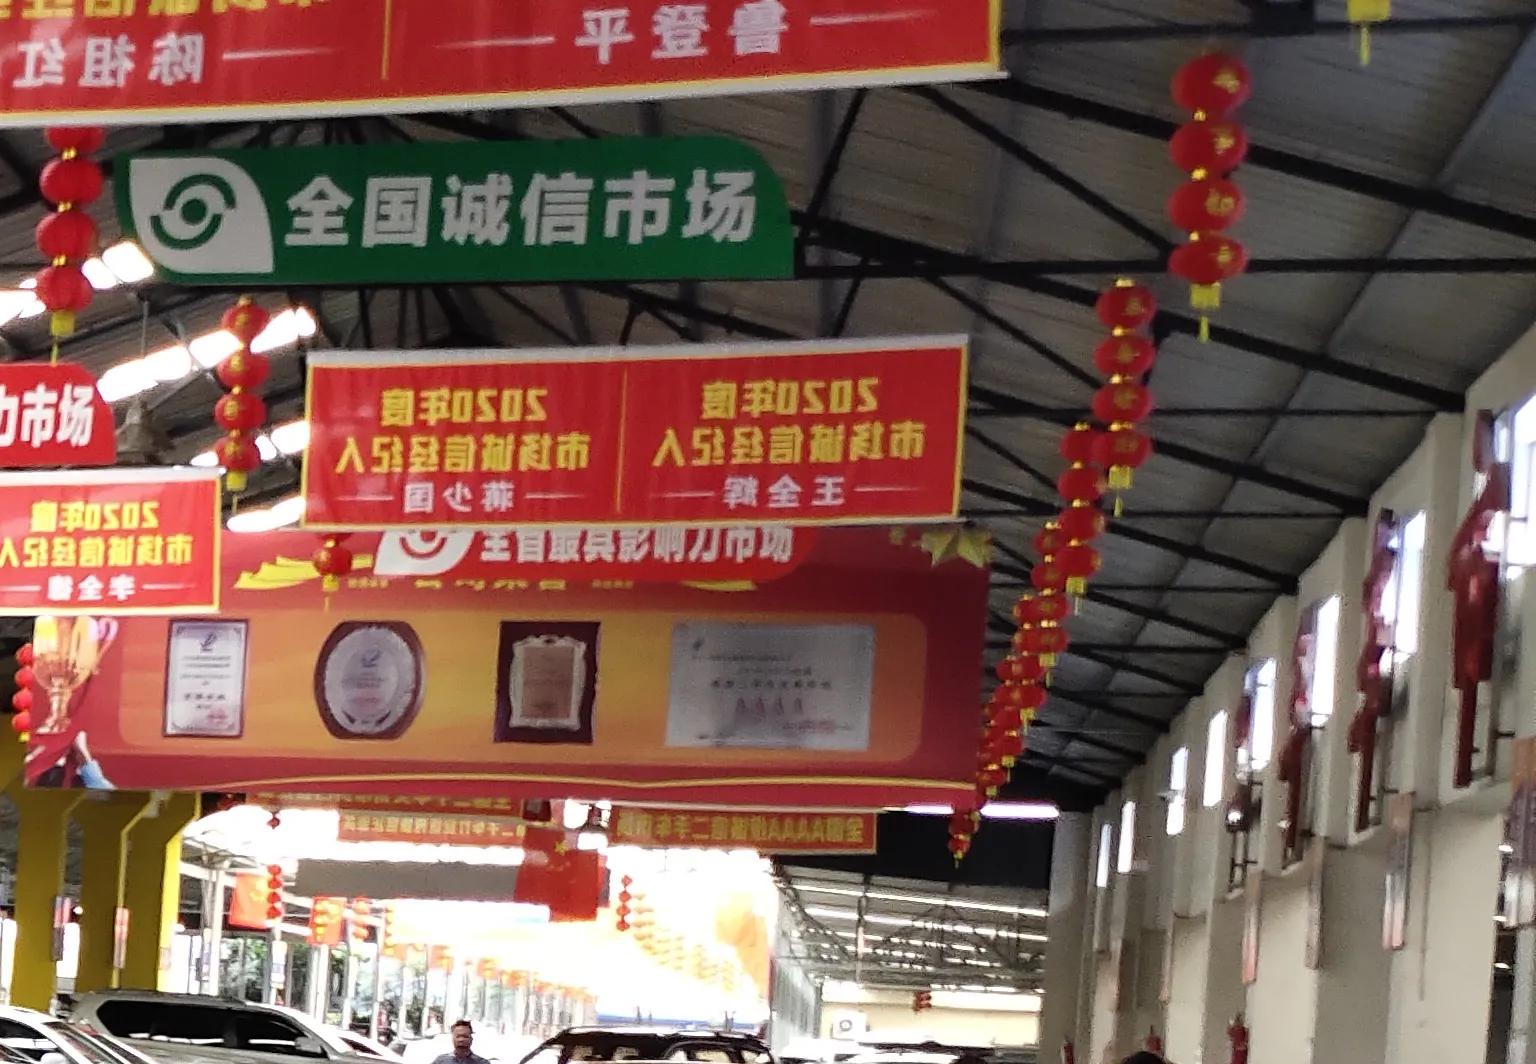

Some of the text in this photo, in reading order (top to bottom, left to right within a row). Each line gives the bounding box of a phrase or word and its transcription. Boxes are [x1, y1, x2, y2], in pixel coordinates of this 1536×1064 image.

[284, 169, 757, 250] 全国诚信市场
